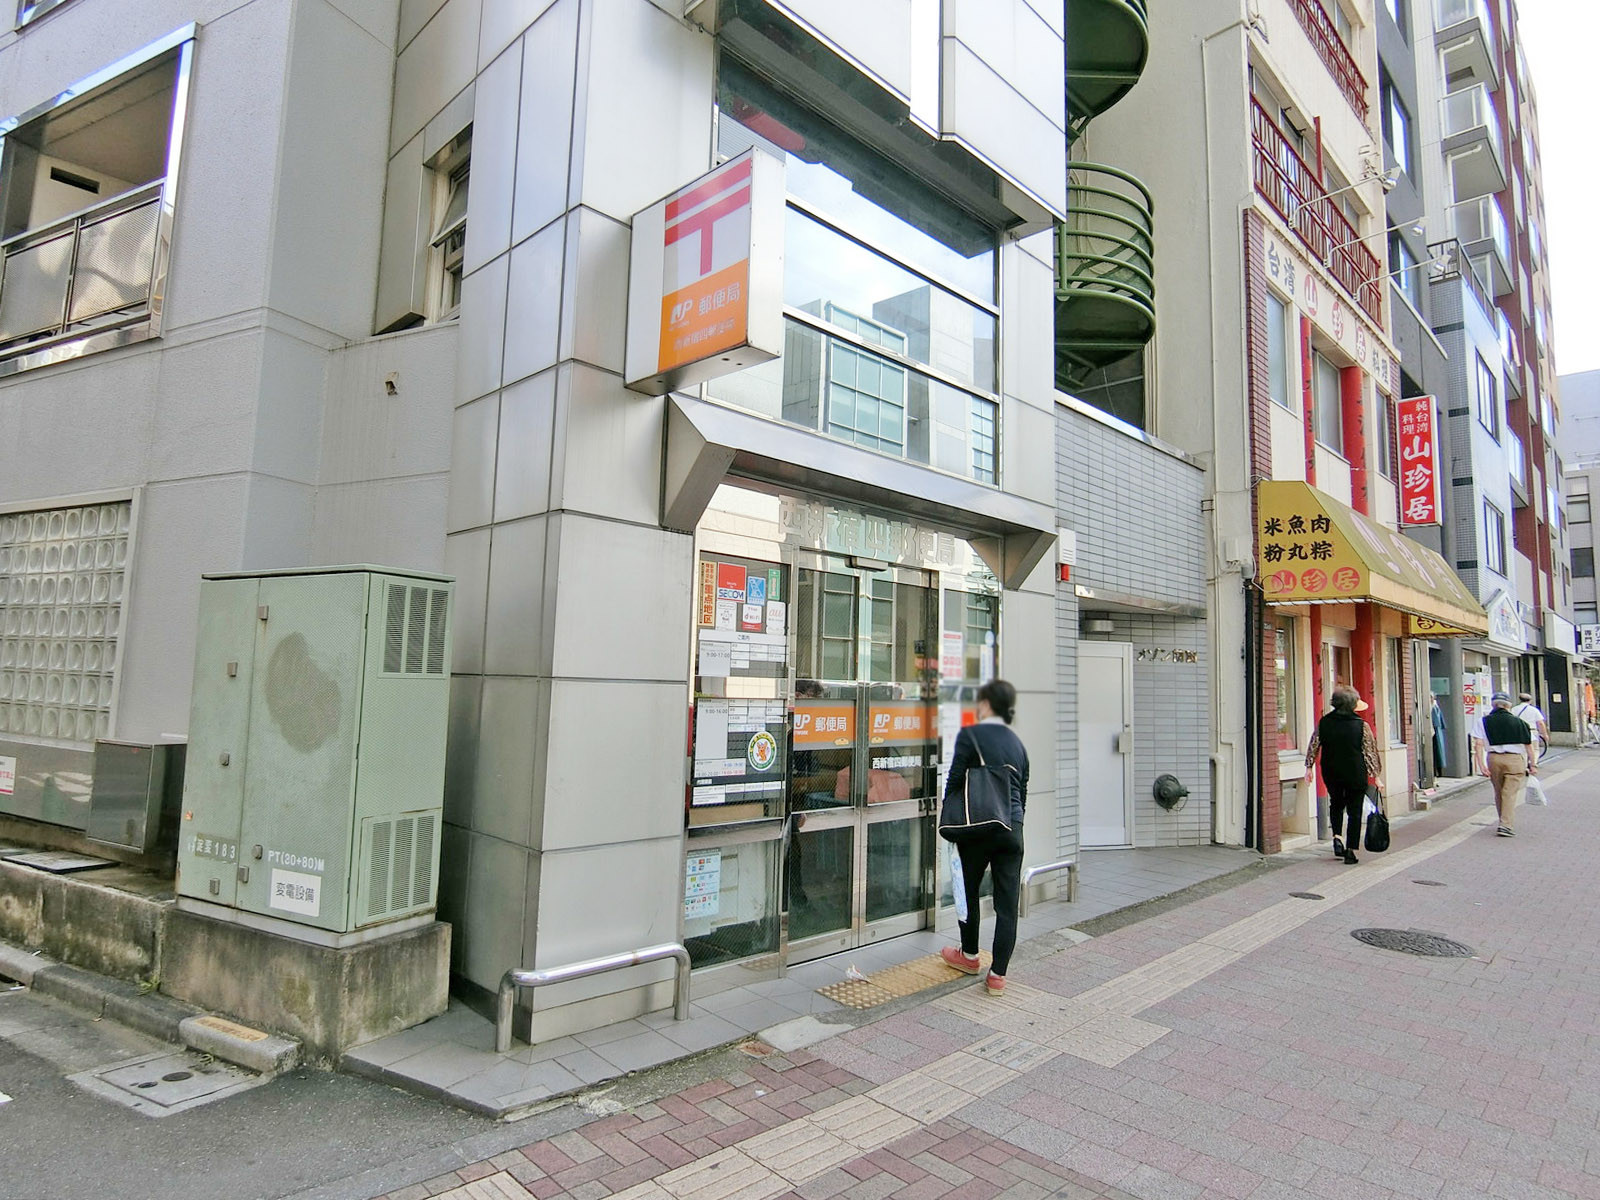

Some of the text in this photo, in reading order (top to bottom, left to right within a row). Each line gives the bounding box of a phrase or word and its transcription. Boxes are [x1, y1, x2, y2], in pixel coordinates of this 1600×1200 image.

[698, 281, 740, 316] 郵便局
[1402, 414, 1415, 435] 料理
[1415, 400, 1429, 433] 純台湾
[1403, 435, 1433, 521] 山珍居
[778, 493, 956, 566] 西新宿四郵便局
[1272, 568, 1359, 593] 山珍居
[718, 589, 744, 599] SECOM
[815, 716, 847, 732] 郵便局
[894, 716, 921, 731] 郵便局
[276, 882, 315, 903] 変電設備
